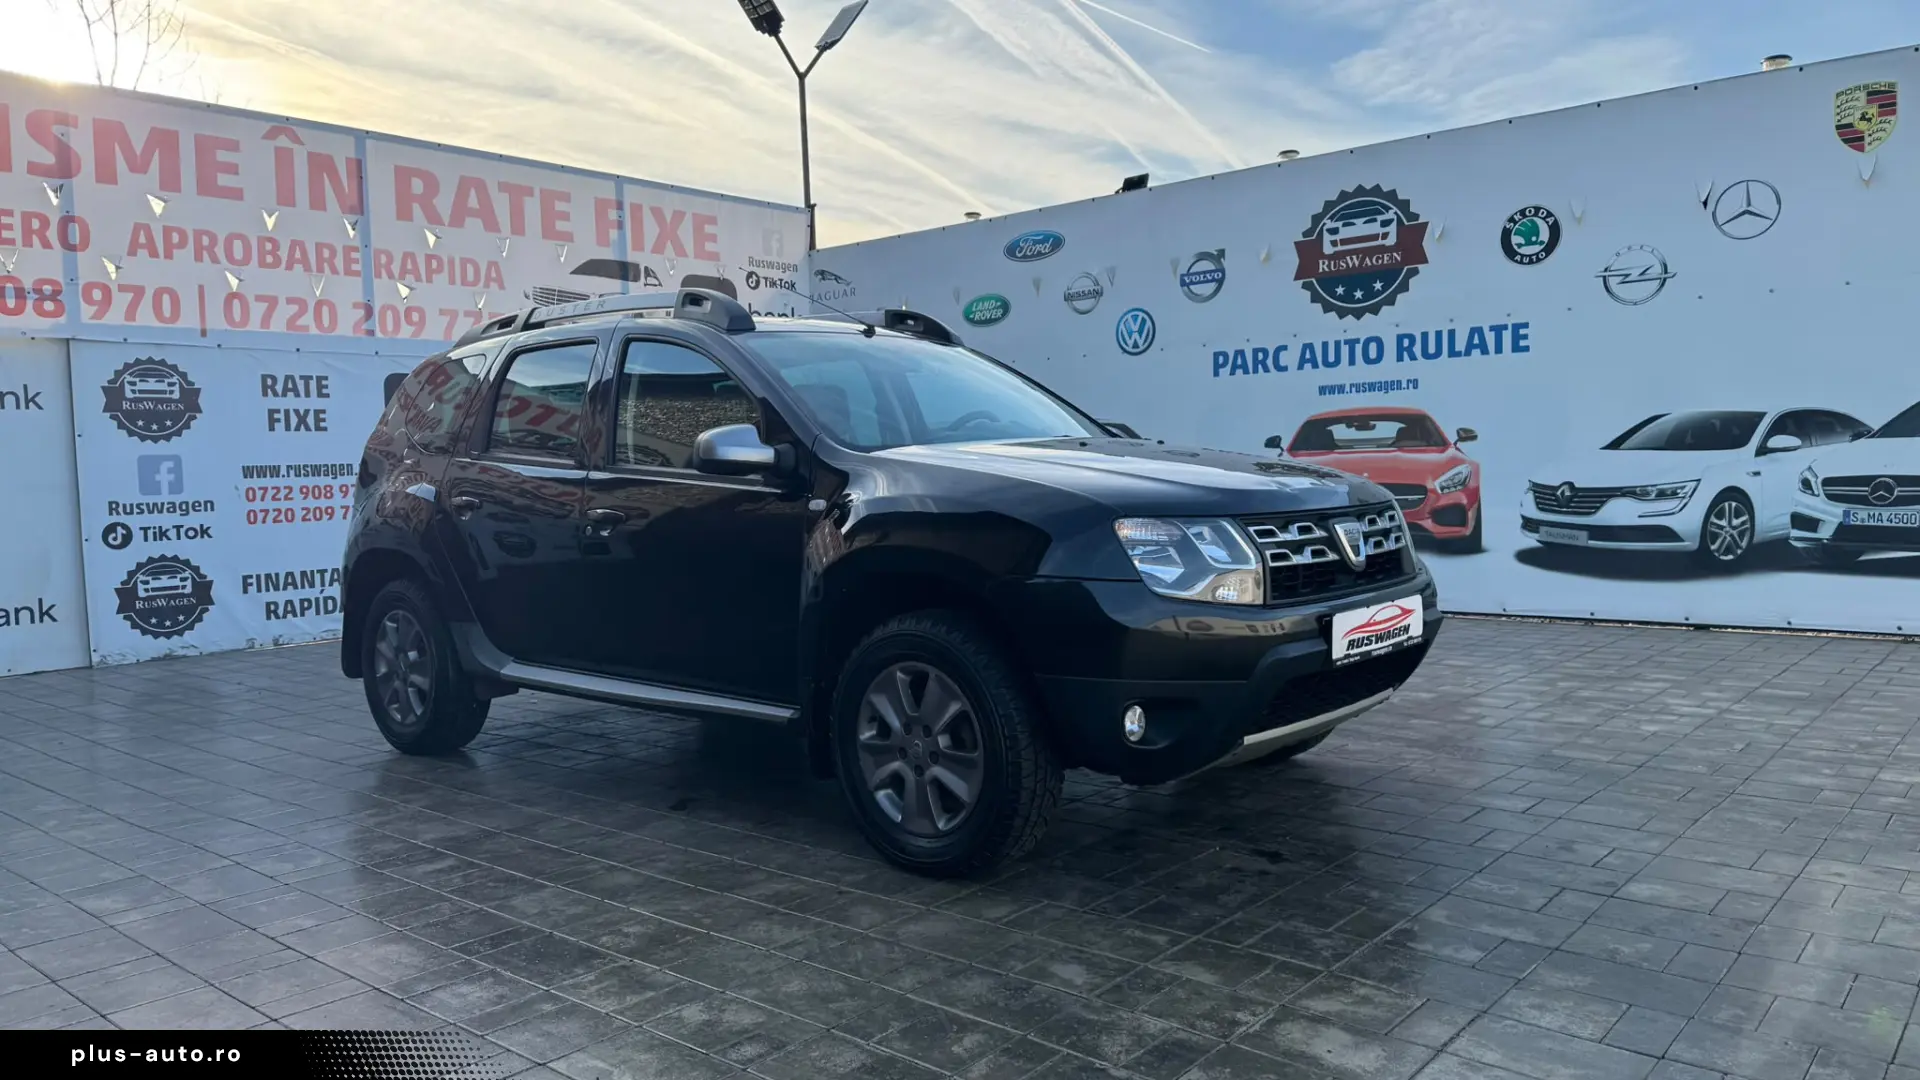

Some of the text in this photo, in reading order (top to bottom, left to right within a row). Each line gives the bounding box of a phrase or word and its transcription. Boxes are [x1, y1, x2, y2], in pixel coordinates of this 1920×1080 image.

[1835, 81, 1897, 100] PORSCHE
[261, 124, 365, 217] ÎN
[393, 164, 575, 243] RATE
[594, 196, 721, 262] FIXE
[1016, 234, 1053, 258] Ford
[126, 221, 362, 278] APROBARE
[372, 247, 506, 291] RAPIDA
[748, 256, 799, 274] Ruswagen
[1514, 251, 1546, 264] AUTO
[763, 276, 797, 291] TikTok
[1183, 271, 1222, 284] VOLVO
[809, 287, 856, 304] JAGUAR
[1066, 288, 1100, 299] NISSAN
[0, 274, 66, 319] 08
[80, 281, 182, 325] 970
[223, 291, 338, 334] 0720
[351, 301, 427, 340] 209
[438, 308, 506, 342] 77
[534, 299, 607, 320] DUSTER
[972, 301, 994, 311] LAND
[974, 309, 1003, 321] ROVER
[1213, 322, 1530, 377] PARC AUTO RULATE
[260, 374, 330, 399] RATE
[1318, 378, 1419, 396] www.ruswagen.ro
[267, 408, 328, 432] FIXE
[242, 463, 361, 480] www.ruswagen.
[245, 486, 294, 502] 0722
[299, 485, 334, 500] 908
[108, 500, 214, 516] Ruswagen
[246, 508, 296, 525] 0720
[301, 506, 335, 522] 209
[1867, 512, 1884, 524] MA
[1887, 513, 1917, 525] 4500
[139, 524, 213, 542] TikTok
[1346, 623, 1411, 652] RUSWAGEN
